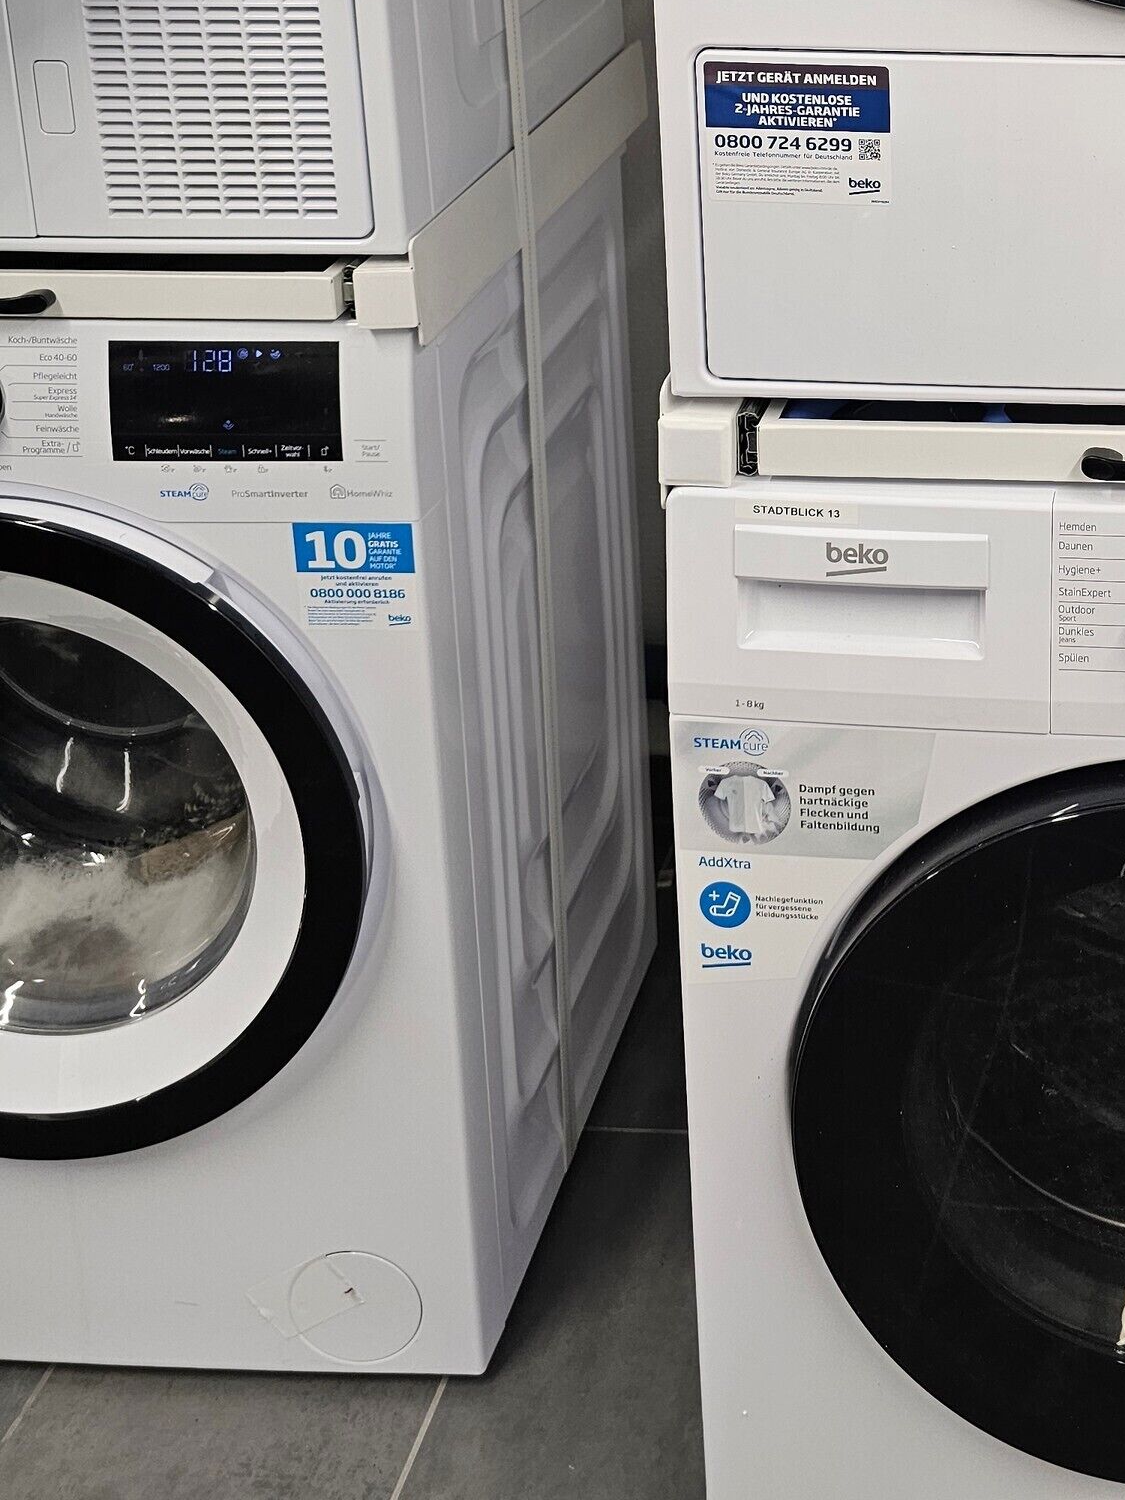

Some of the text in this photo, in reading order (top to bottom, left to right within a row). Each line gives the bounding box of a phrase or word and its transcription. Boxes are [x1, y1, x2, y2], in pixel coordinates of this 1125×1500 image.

[716, 70, 877, 86] JETZT GERÄT ANMELDEN
[742, 92, 852, 106] UND KOSTENLOSE
[735, 103, 860, 117] 2-JAHRES-GARANTIE
[715, 134, 852, 152] 0800 724 6299
[714, 150, 853, 161] Kostenfreie Telefonnummer Deutschland
[849, 177, 881, 189] beko
[8, 336, 78, 345] Koch-/Buntwäsche
[192, 350, 233, 372] 128
[33, 372, 78, 382] Pflegeleicht
[48, 387, 78, 396] Express
[35, 425, 80, 433] Feinwäsche
[22, 446, 66, 455] Programme
[231, 490, 309, 499] ProSmartInverter
[753, 505, 841, 518] STADTBLICK 13
[1059, 522, 1097, 532] Hemden
[368, 532, 392, 540] JAHRE
[368, 540, 399, 548] GRATIS
[1058, 541, 1093, 551] Daunen
[305, 530, 367, 570] 10
[826, 542, 889, 565] beko
[1058, 565, 1102, 577] Hygiene+
[310, 588, 406, 599] 0800 000 8186
[1058, 587, 1112, 599] StainExpert
[1058, 604, 1095, 615] Outdoor
[1059, 614, 1077, 623] Sport
[1058, 627, 1095, 637] Dunkles
[1058, 652, 1090, 664] Spülen
[799, 784, 876, 797] Dampf gegen
[799, 796, 869, 808] hartnäckige
[800, 808, 869, 820] Flecken und
[800, 820, 881, 834] Faltenbildung
[698, 856, 752, 869] AddXtra
[755, 895, 824, 905] Nachlegefunktion
[768, 904, 812, 912] vergessene
[755, 911, 819, 921] Kleidungsstücke
[701, 943, 753, 961] beko
